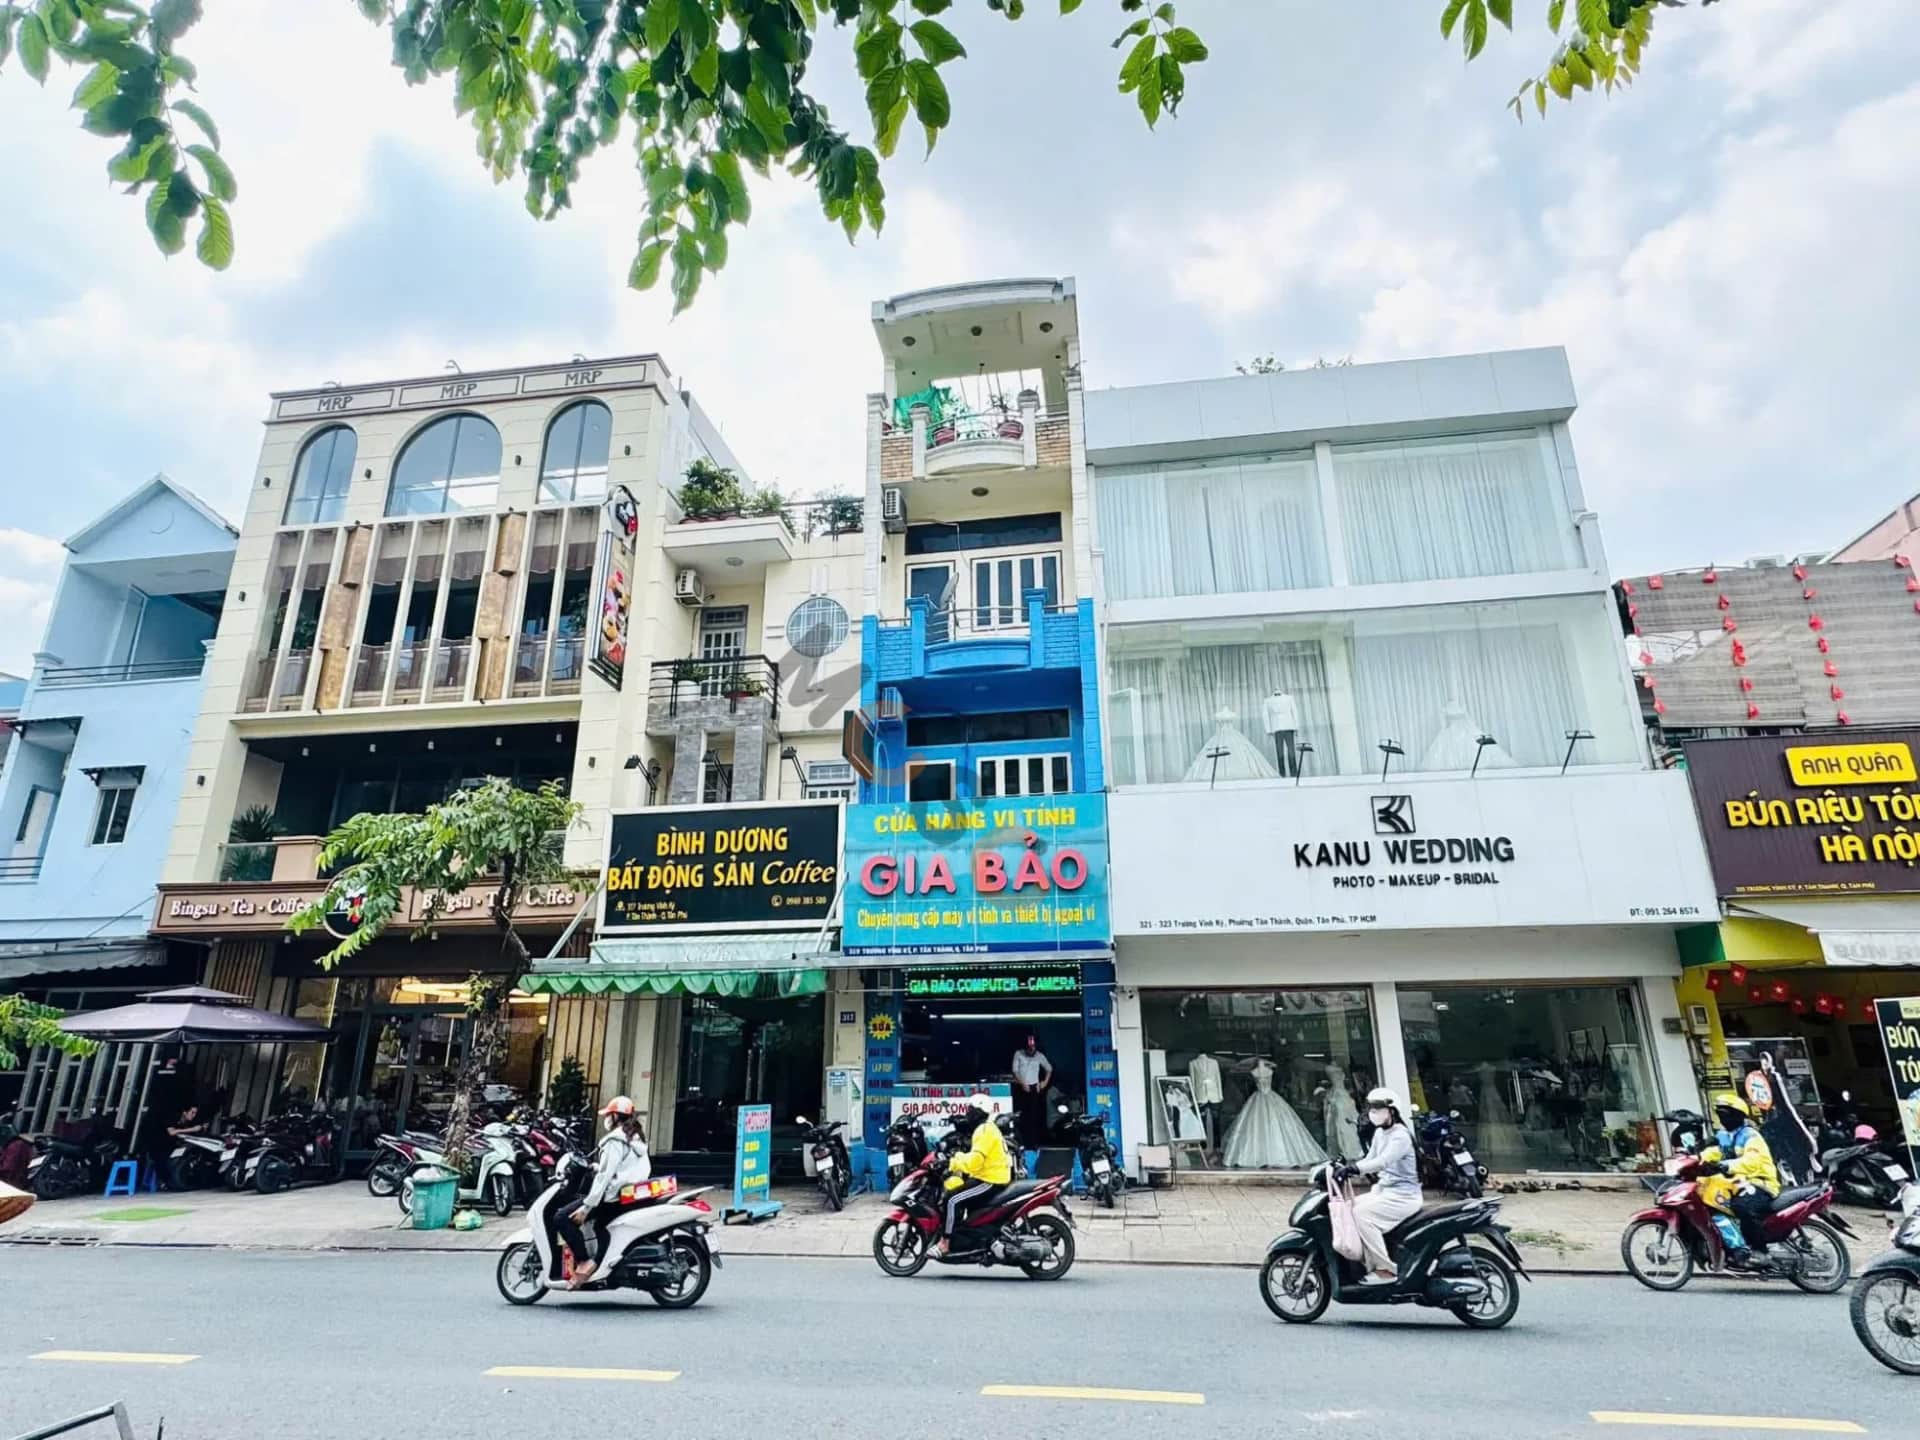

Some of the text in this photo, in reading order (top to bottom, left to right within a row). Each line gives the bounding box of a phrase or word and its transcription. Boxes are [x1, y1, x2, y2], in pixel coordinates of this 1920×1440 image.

[564, 370, 603, 387] MRP
[440, 383, 478, 399] MRP
[1801, 752, 1904, 776] ANH QUÂN
[873, 803, 1077, 833] CỬA HÀNG VI TÍNH
[1726, 789, 1794, 828] BÚN
[1794, 788, 1865, 826] RIÊU
[656, 826, 788, 856] BÌNH DƯƠNG
[1294, 836, 1515, 868] KANU WEDDING
[1819, 825, 1868, 863] HÀ
[607, 854, 836, 895] BẤT ĐỘNG SẢN Coffee
[860, 830, 1089, 897] GIA BẢO
[1332, 875, 1375, 888] PHOTO
[1388, 873, 1441, 887] MAKEUP
[1454, 872, 1499, 885] BRIDAL
[170, 899, 219, 920] Bingsu
[230, 898, 256, 915] Tea
[267, 896, 312, 914] Coffee
[422, 893, 473, 913] Bgsu
[1139, 920, 1152, 929] 321
[1159, 920, 1172, 928] 323
[908, 979, 929, 994] GIA
[956, 978, 1019, 993] COMPUTER
[1896, 1055, 1920, 1083] TÓ
[902, 1102, 919, 1114] GIA
